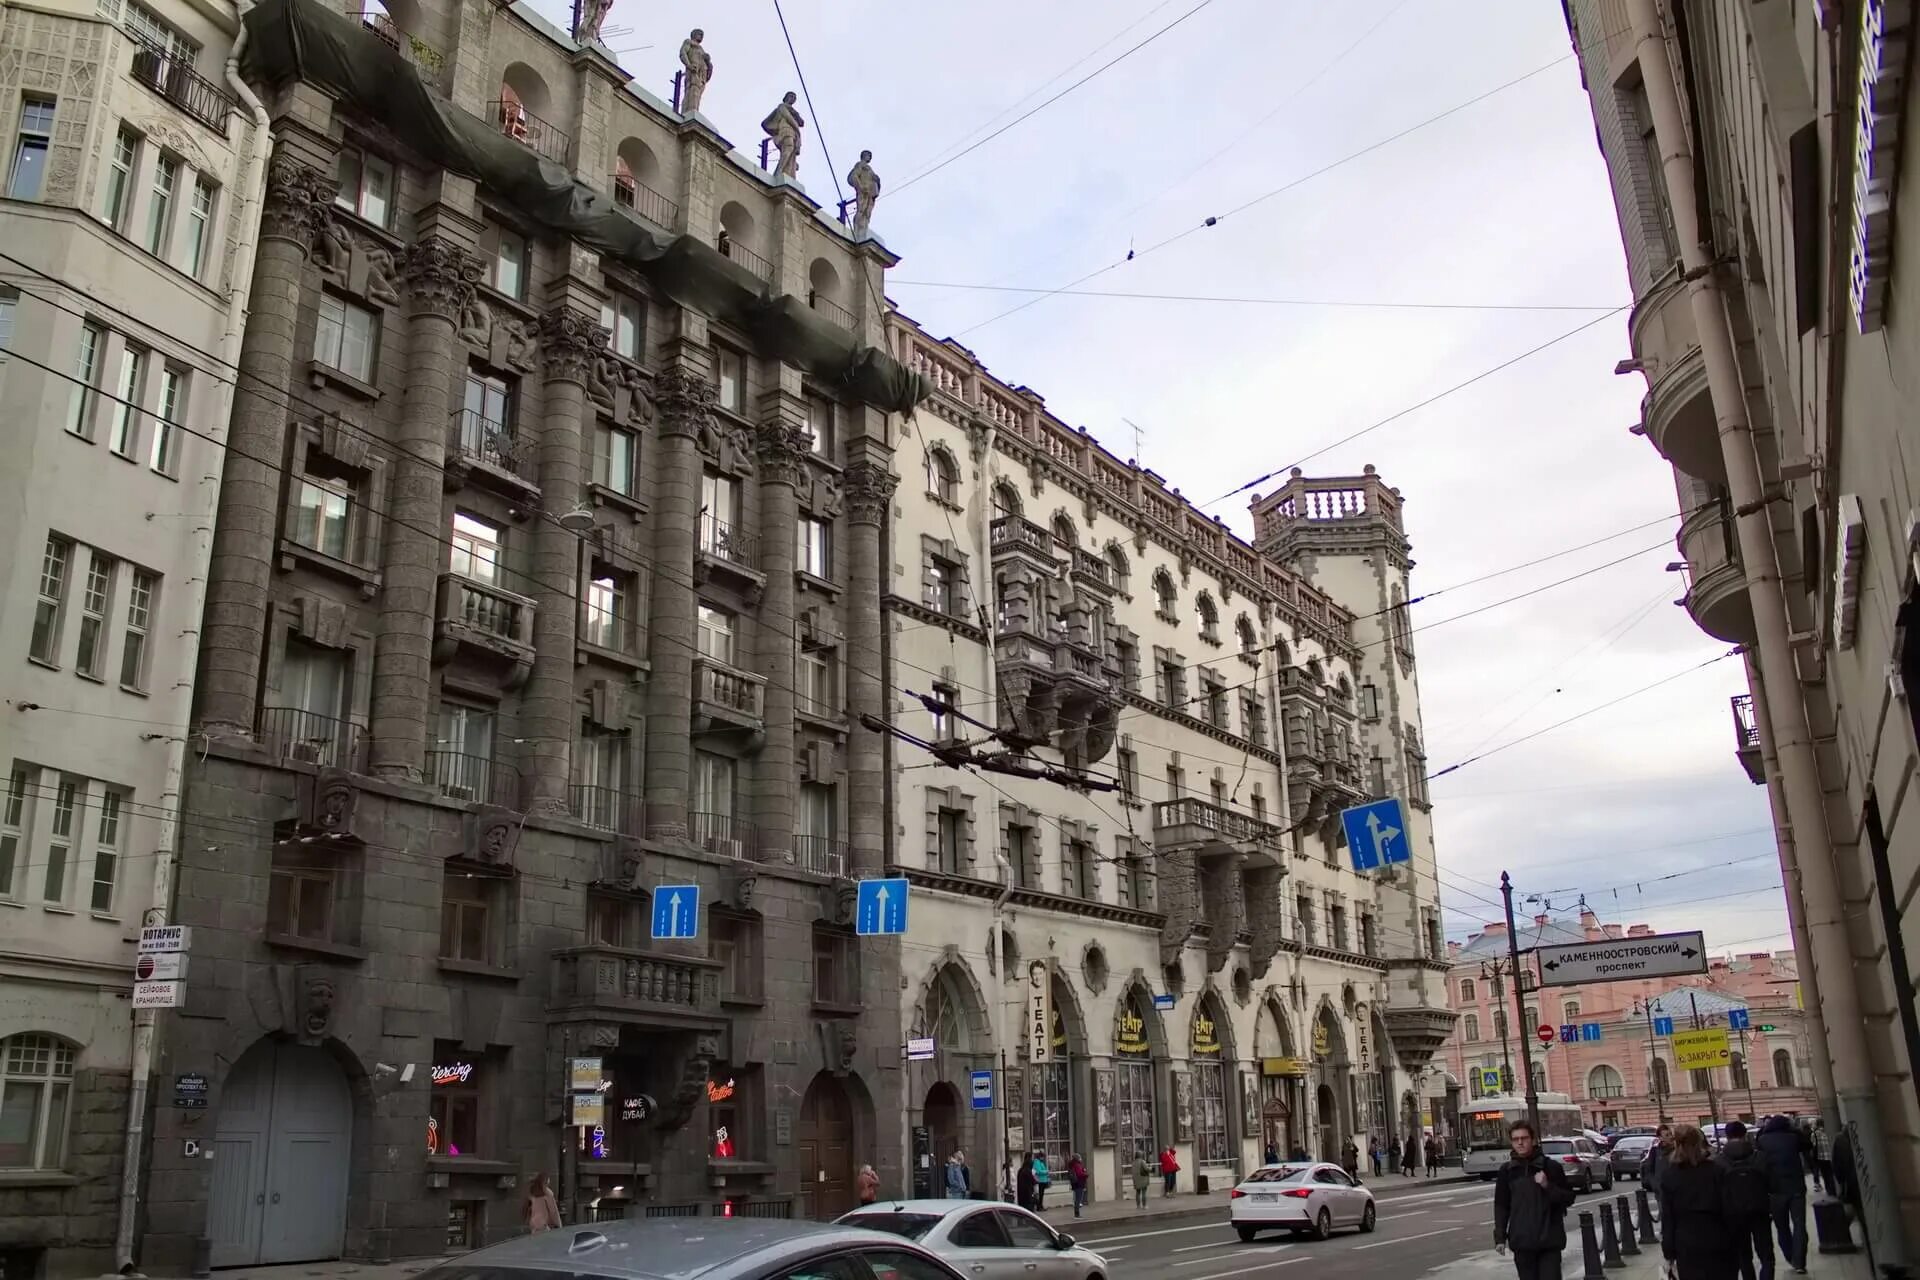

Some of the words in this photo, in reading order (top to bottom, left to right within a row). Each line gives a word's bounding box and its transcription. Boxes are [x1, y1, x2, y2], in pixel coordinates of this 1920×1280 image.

[143, 928, 181, 940] НОТАРИУС
[1559, 941, 1680, 964] КАМЕННООСТРОВСКИЙ
[1595, 961, 1646, 974] проспект
[139, 985, 171, 993] СЕЙФОВОЕ
[1034, 996, 1045, 1060] ТЕАТР
[1195, 1013, 1214, 1035] ЕАТР
[1674, 1036, 1709, 1047] БИРЖЕВОЙ
[1359, 1027, 1370, 1071] ТЕАТР
[1688, 1049, 1717, 1063] ЗАКРЫТ
[624, 1098, 644, 1108] КАФЕ
[622, 1108, 646, 1120] ДУБАЙ
